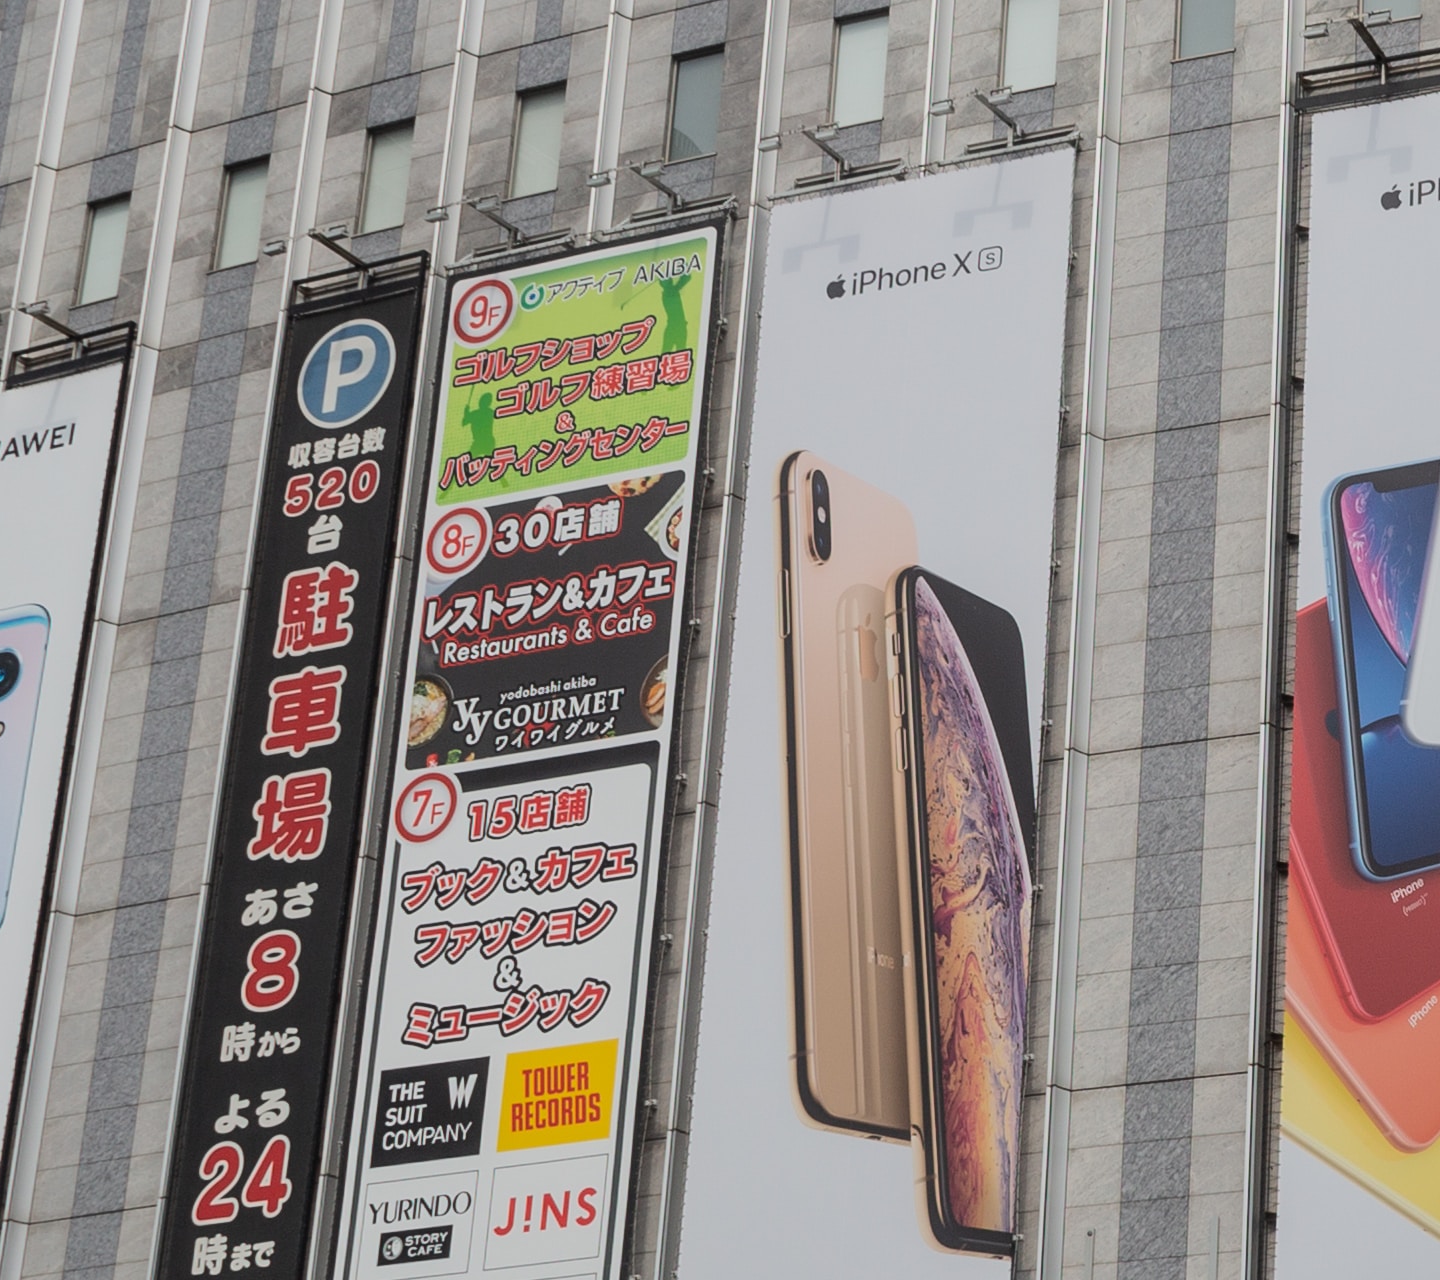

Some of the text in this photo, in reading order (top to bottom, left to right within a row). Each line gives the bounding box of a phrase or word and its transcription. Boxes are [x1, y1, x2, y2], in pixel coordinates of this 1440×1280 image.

[546, 252, 704, 304] アクティブ AKIBA
[287, 425, 387, 469] 収容台数
[282, 459, 381, 517] 520
[306, 514, 346, 555] 台
[440, 609, 655, 668] Restaurants & Cafe
[498, 673, 599, 705] yodobashi akiba
[248, 562, 360, 863] 駐車場
[493, 714, 618, 754] ワイワイグルメ
[240, 927, 302, 1013] 8
[218, 1021, 302, 1064] 時から
[388, 1080, 427, 1104] THE
[522, 1060, 591, 1099] TOWER
[385, 1103, 428, 1128] SUIT
[510, 1091, 602, 1134] RECORDS
[381, 1121, 474, 1153] COMPANY
[190, 1132, 292, 1227] 24
[368, 1190, 474, 1227] YURINDO
[189, 1233, 276, 1277] 時まで
[404, 1230, 449, 1249] STORY
[406, 1241, 445, 1258] CAFE
